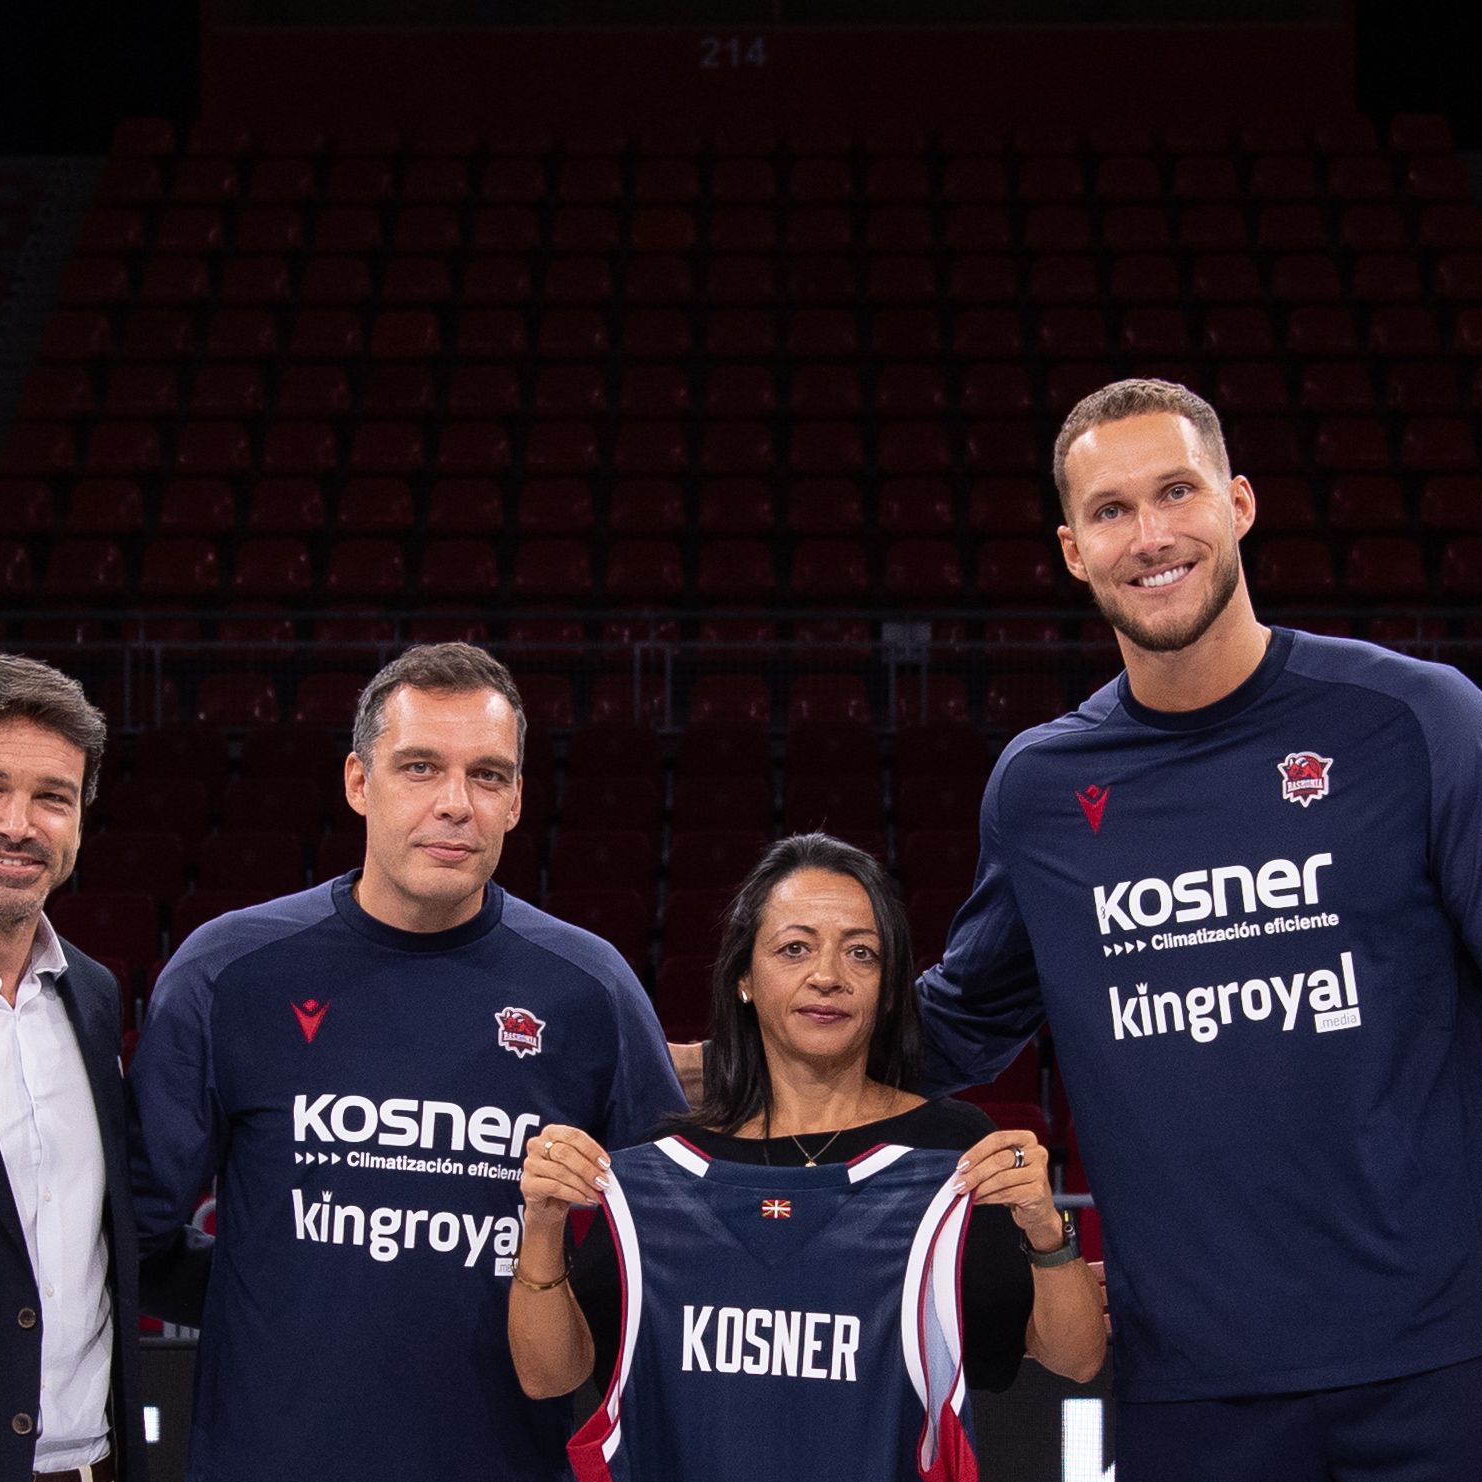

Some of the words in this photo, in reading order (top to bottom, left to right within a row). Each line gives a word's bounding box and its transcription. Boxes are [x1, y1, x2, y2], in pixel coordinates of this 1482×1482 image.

[699, 34, 767, 69] 214
[1151, 920, 1261, 951] Climatización
[1264, 911, 1339, 935] eficiente
[1109, 951, 1358, 1043] kingroyal
[346, 1151, 464, 1175] Climatización
[468, 1165, 523, 1181] eficient
[682, 1305, 860, 1381] KOSNER
